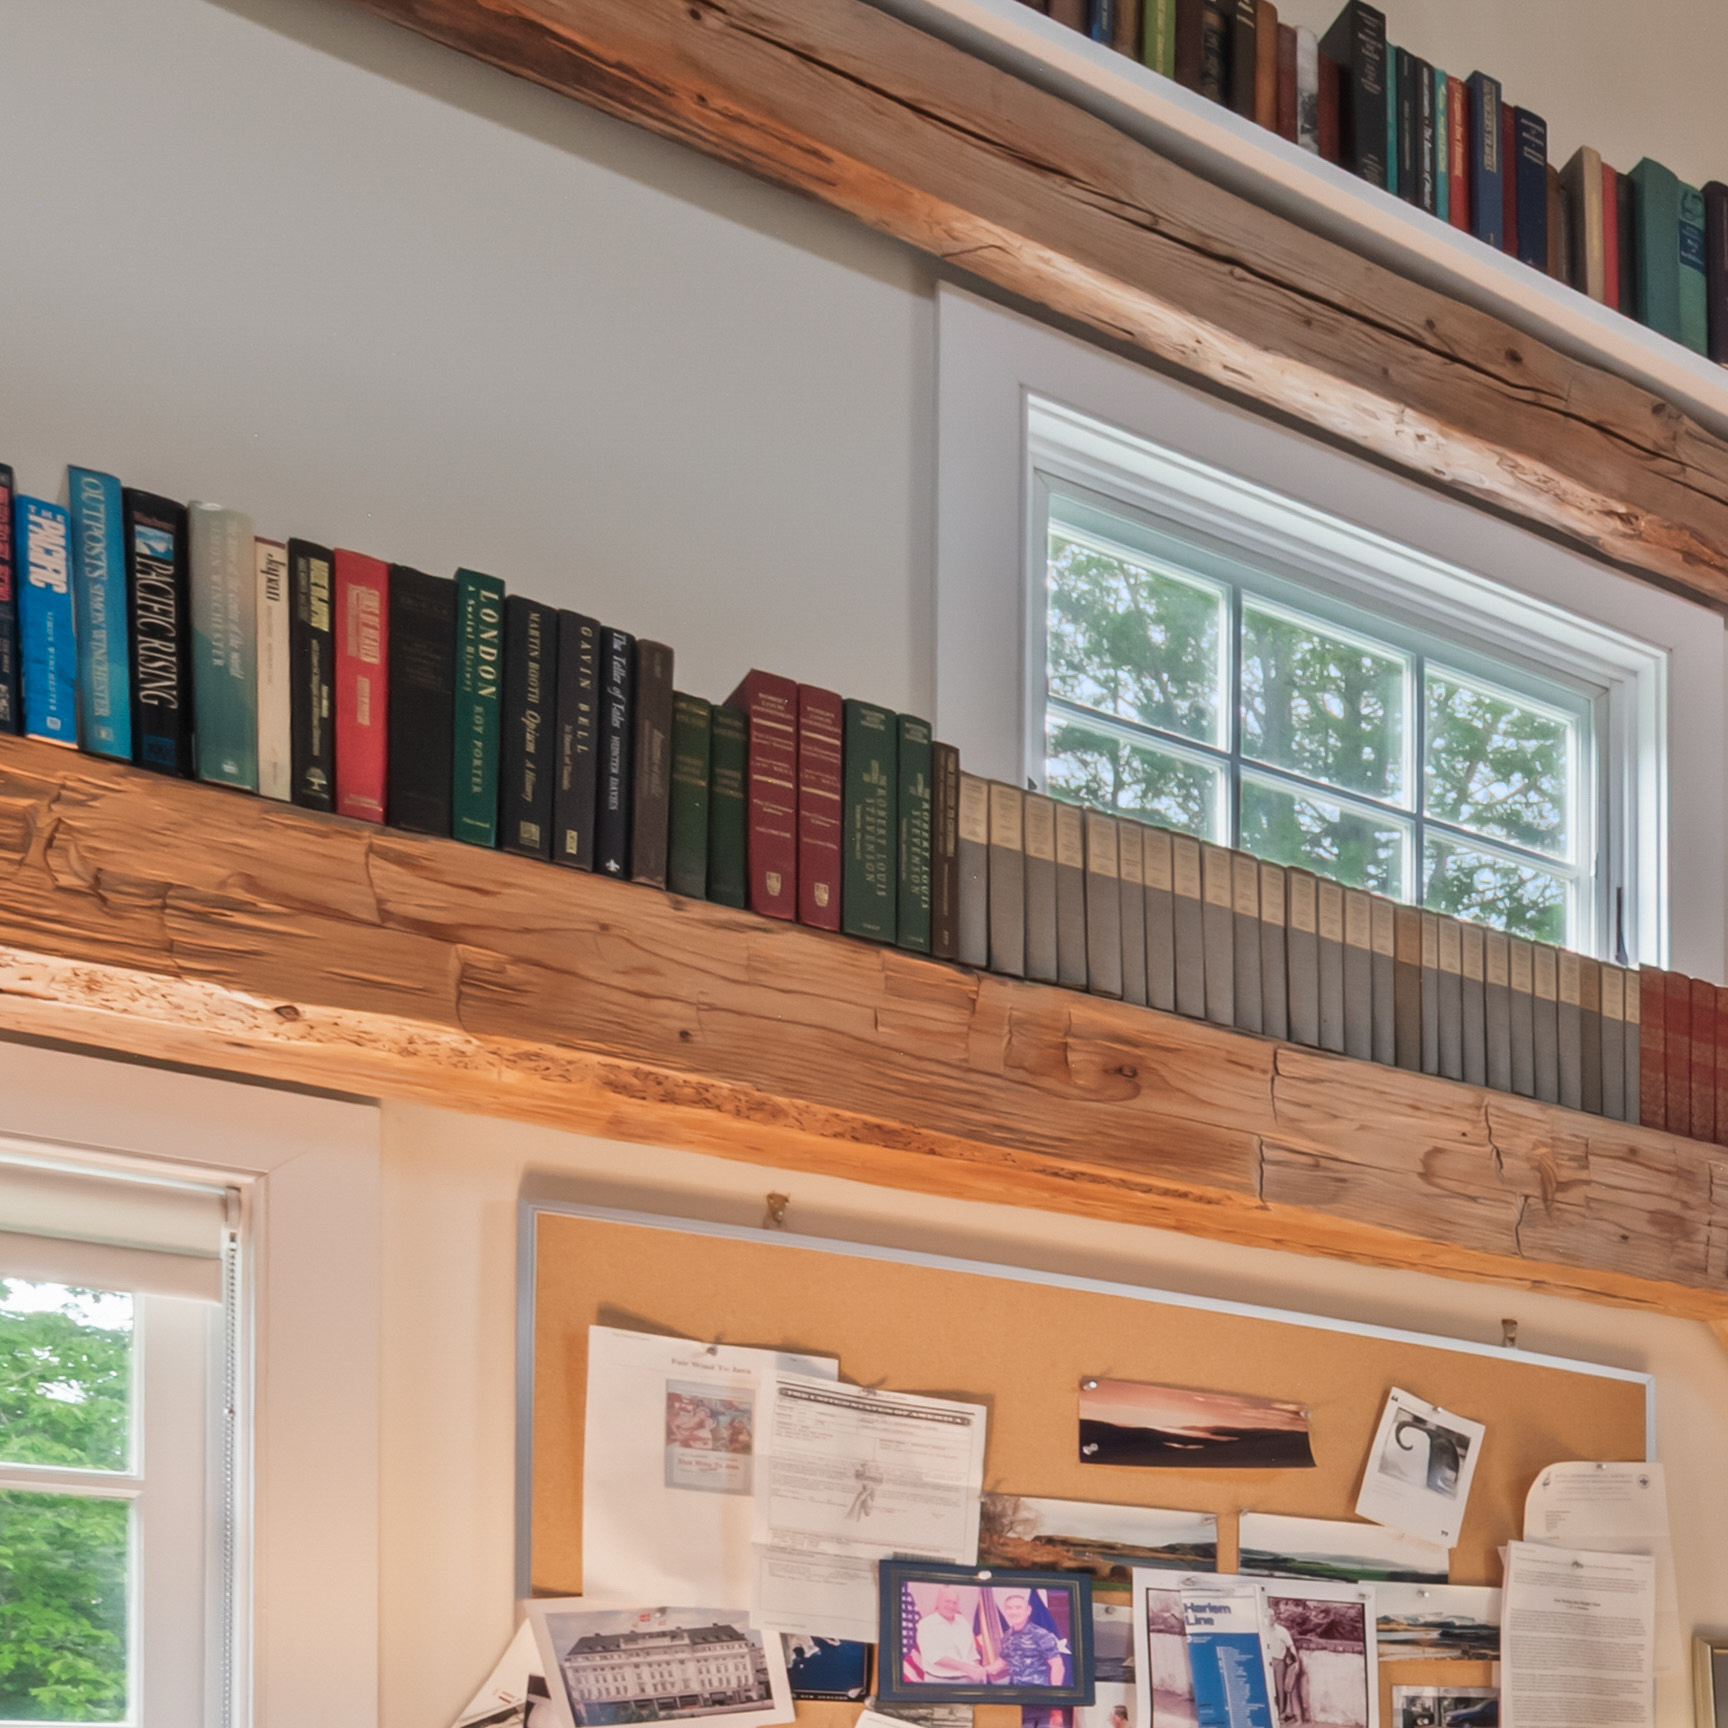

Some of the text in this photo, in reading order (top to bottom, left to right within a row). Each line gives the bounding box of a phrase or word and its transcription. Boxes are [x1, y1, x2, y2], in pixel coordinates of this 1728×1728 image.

[136, 556, 178, 710] PACIFIC RISING
[612, 631, 628, 651] The
[612, 655, 627, 685] Teller
[472, 589, 500, 793] LONDON ROY PORTER
[577, 626, 593, 752] GAVIN BELL
[610, 702, 626, 729] Tales
[521, 709, 541, 754] Opium
[1184, 1601, 1231, 1617] Harlem
[1185, 1614, 1214, 1628] Line
